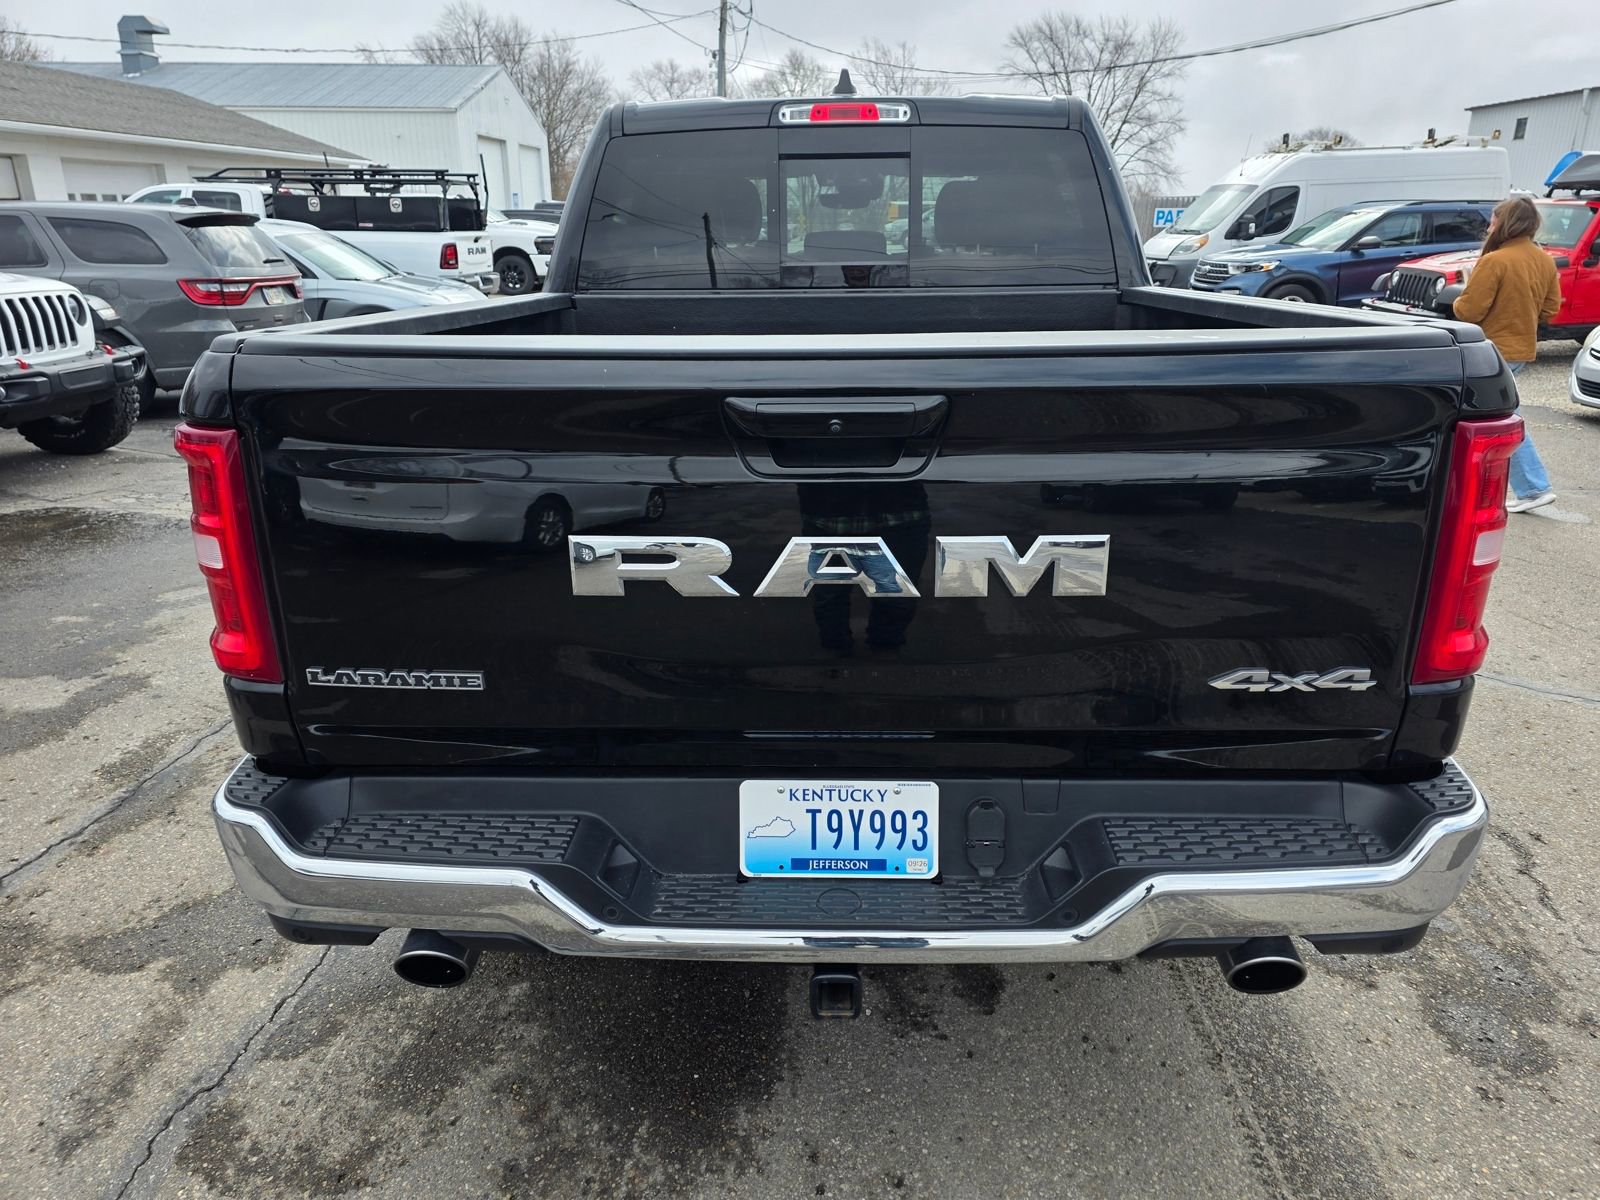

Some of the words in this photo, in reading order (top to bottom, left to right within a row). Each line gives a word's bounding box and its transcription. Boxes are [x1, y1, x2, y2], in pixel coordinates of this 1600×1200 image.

[467, 247, 487, 255] RAM
[567, 534, 1112, 597] RAM
[306, 667, 485, 690] LARAMIE
[1208, 667, 1377, 692] 4x4
[788, 788, 888, 803] KENTUCKY
[805, 808, 929, 852] T9Y993
[808, 860, 869, 870] JEFFERSON
